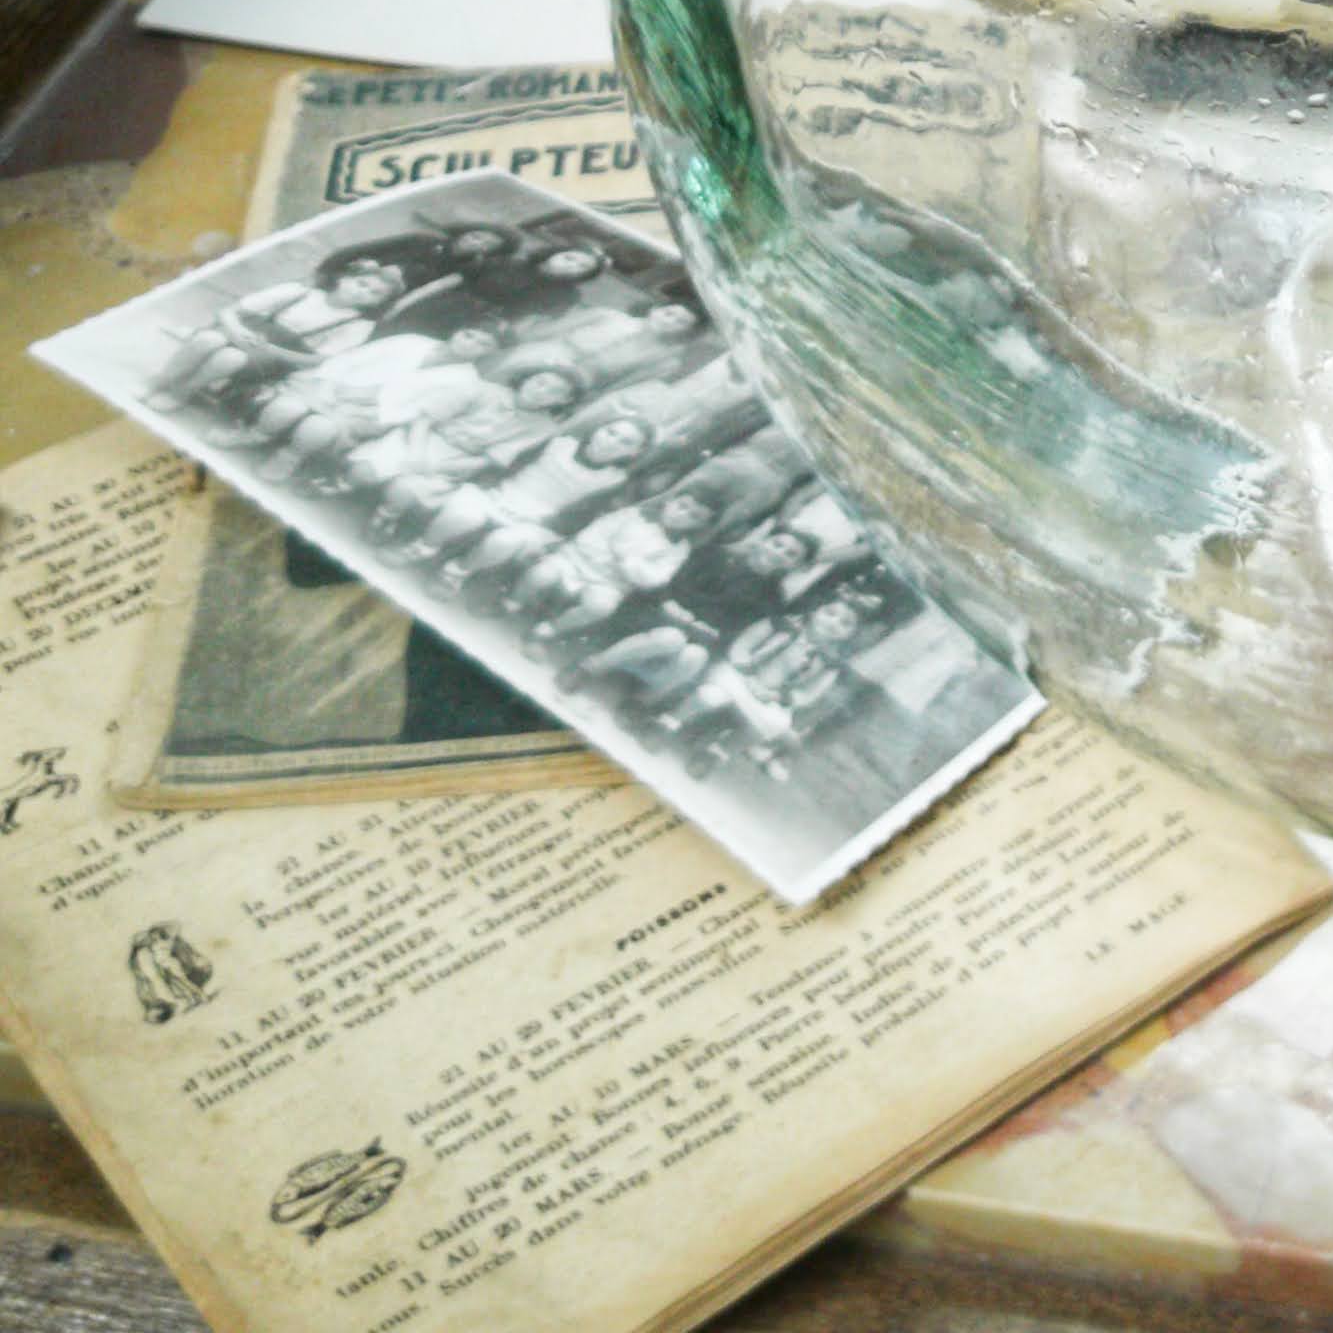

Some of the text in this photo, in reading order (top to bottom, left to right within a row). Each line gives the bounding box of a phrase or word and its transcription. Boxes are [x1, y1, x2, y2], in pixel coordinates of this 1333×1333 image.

[615, 882, 727, 952] POISSONS
[801, 968, 851, 1005] pour
[416, 1195, 510, 1252] Chiffres
[559, 1121, 637, 1171] chance
[527, 1209, 584, 1246] dans
[591, 1169, 651, 1206] votre
